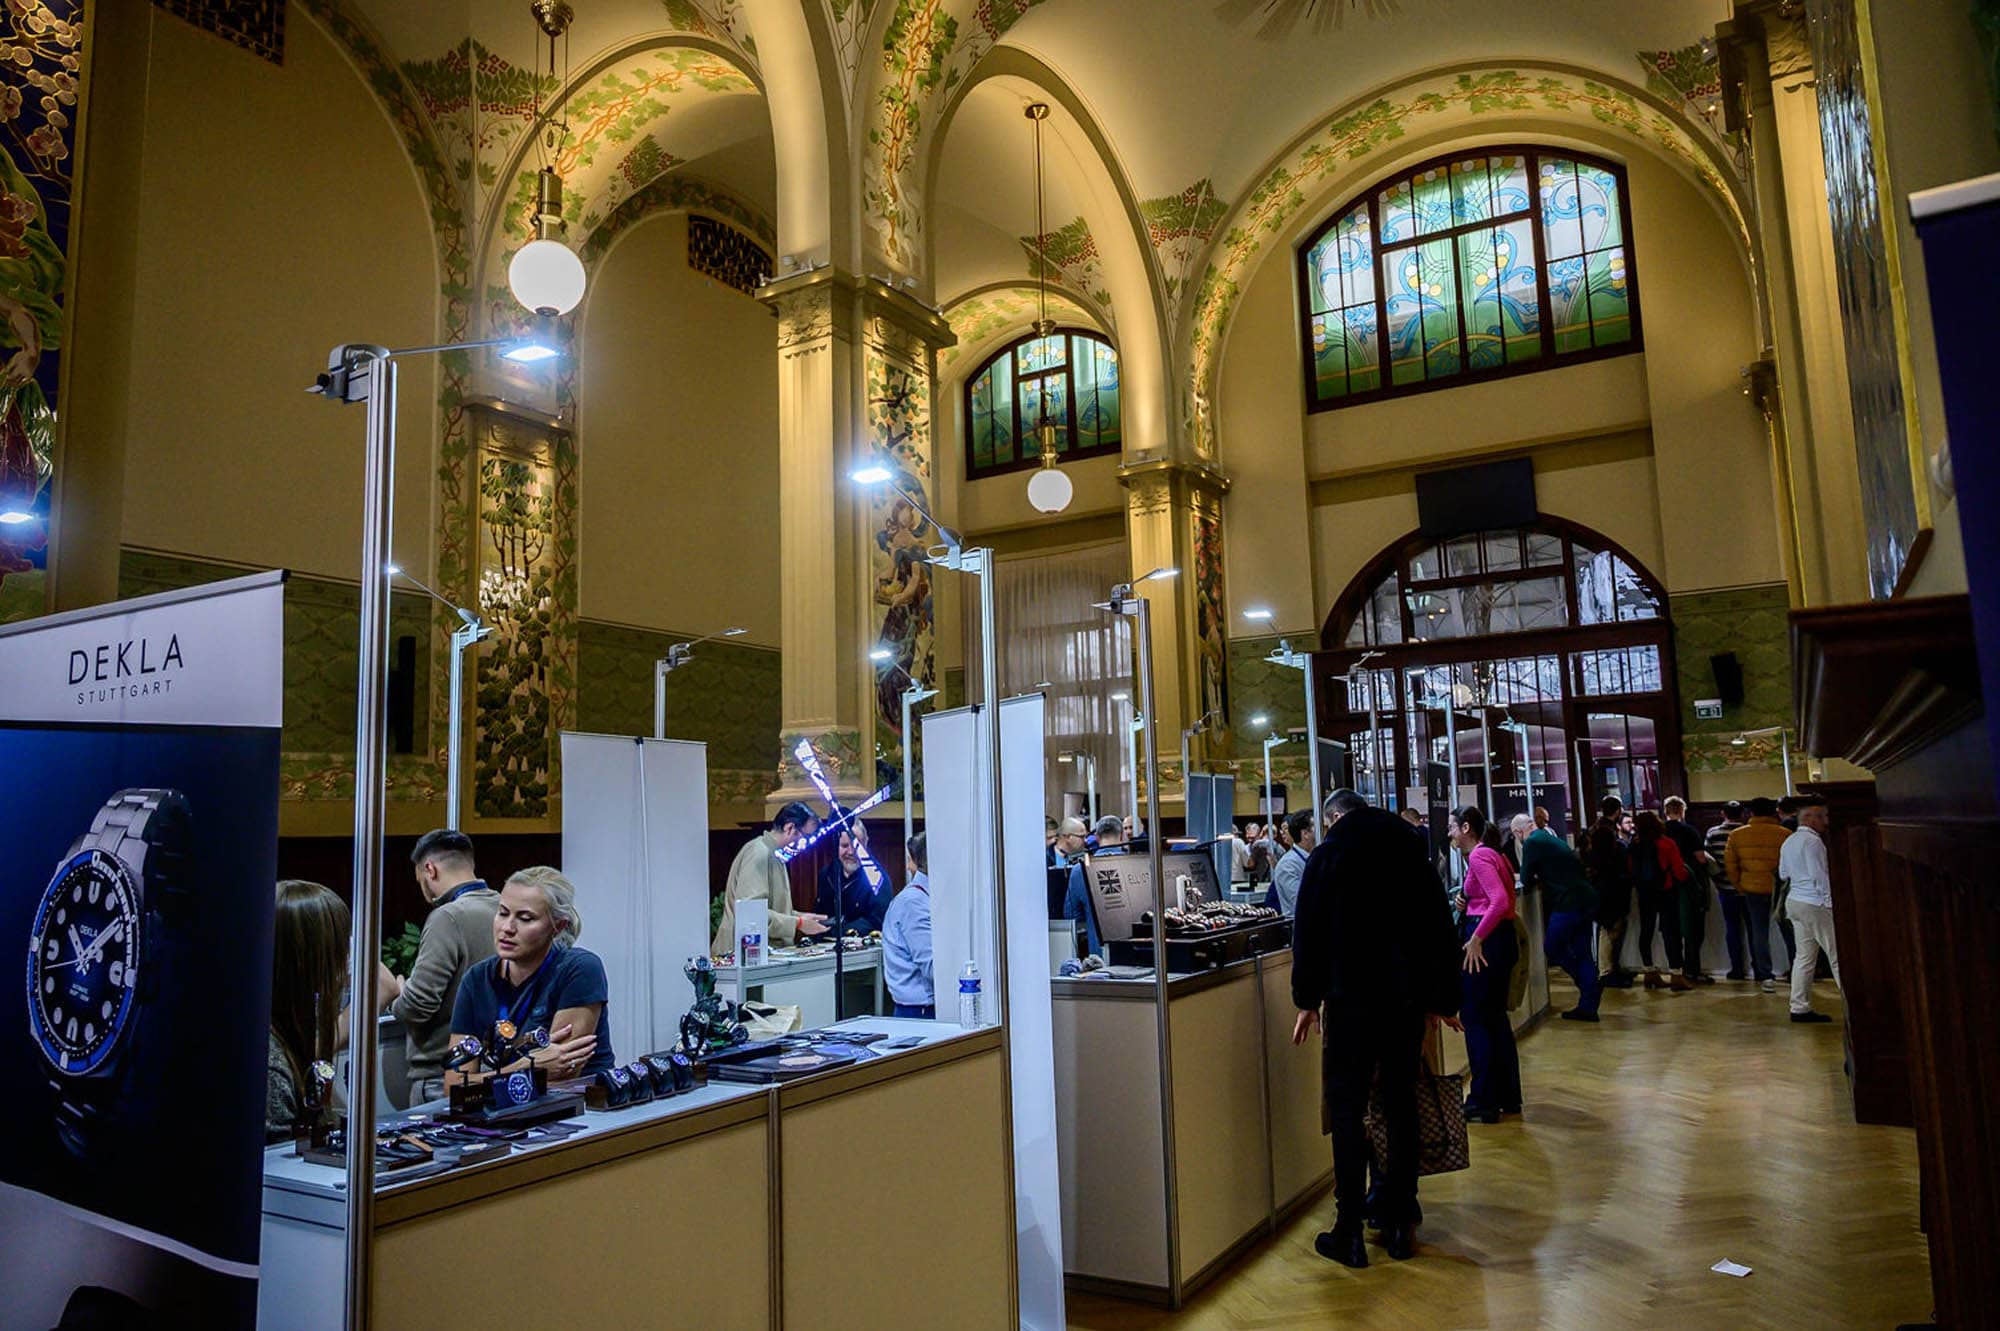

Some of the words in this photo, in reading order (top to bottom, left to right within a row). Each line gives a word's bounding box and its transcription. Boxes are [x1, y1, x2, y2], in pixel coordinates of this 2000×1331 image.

[68, 633, 183, 685] DEKLA
[77, 679, 171, 705] STUTTGART
[1508, 788, 1545, 798] MAN
